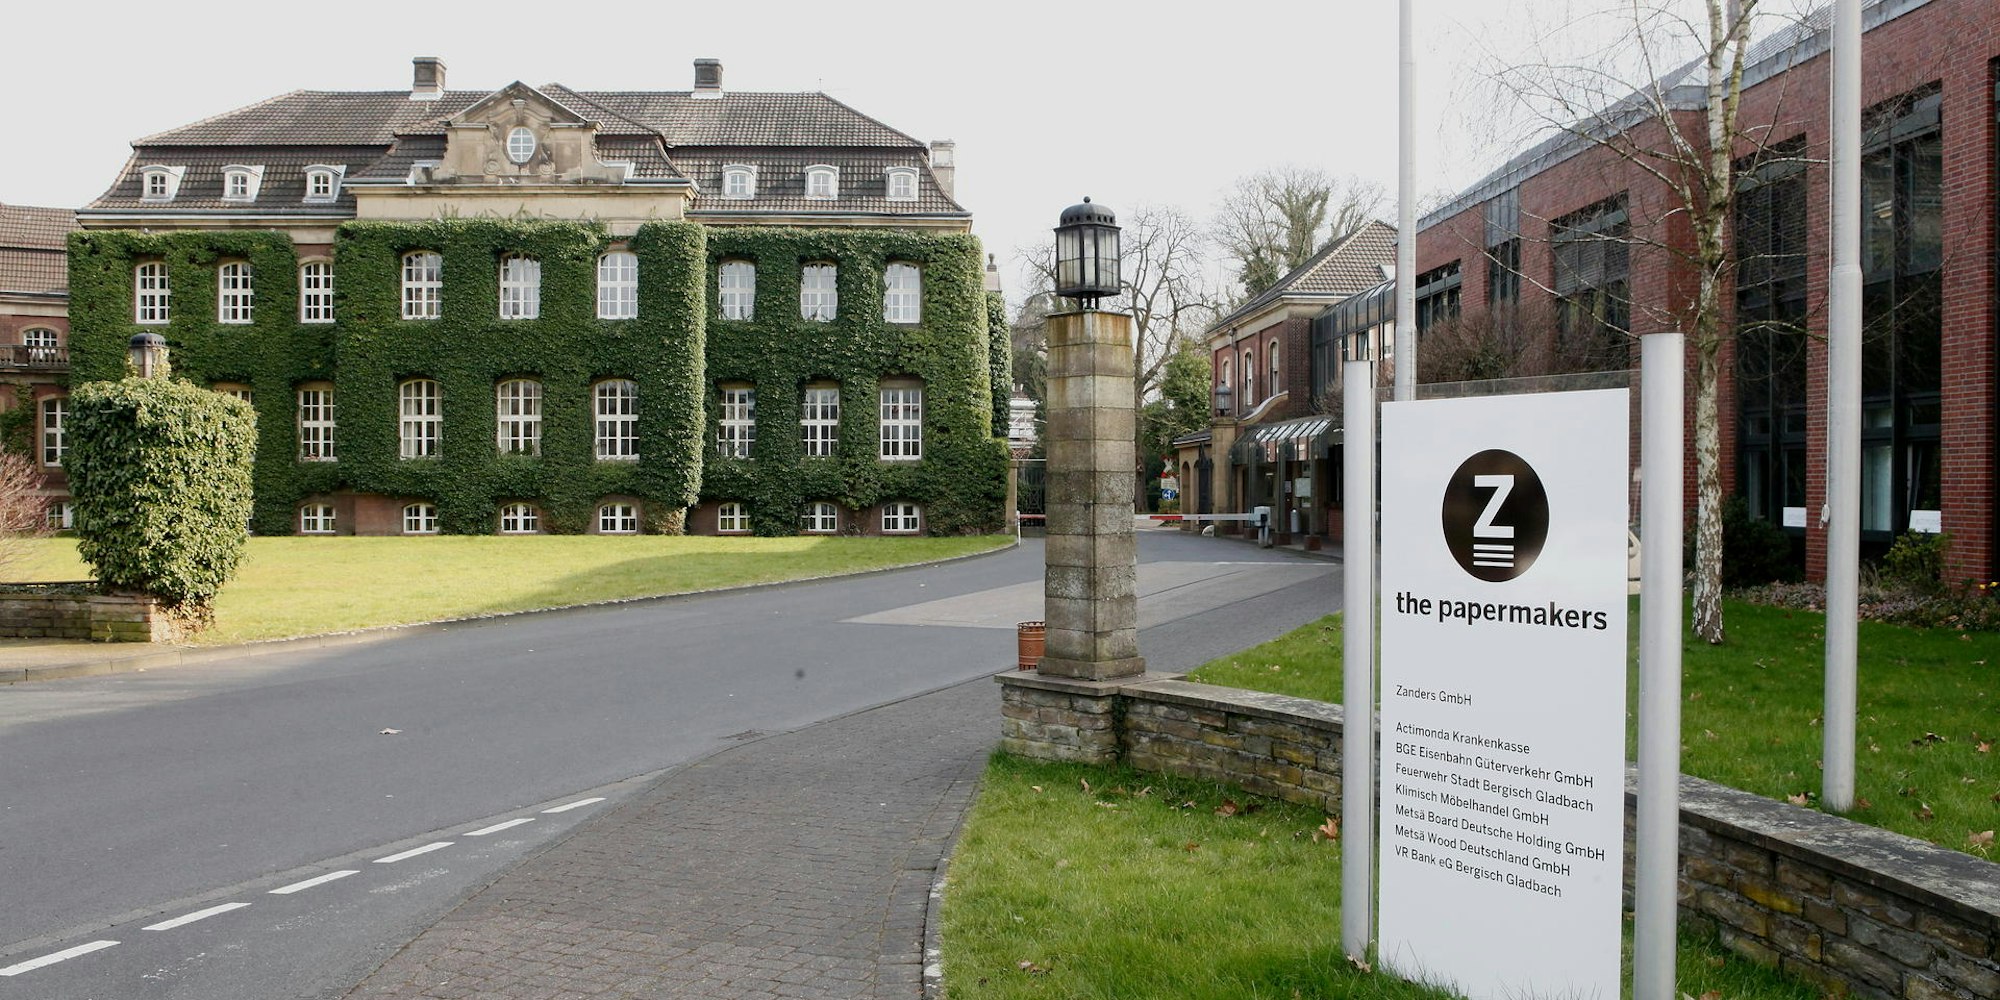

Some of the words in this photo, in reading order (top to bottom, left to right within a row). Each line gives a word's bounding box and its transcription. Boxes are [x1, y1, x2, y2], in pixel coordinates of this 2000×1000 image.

[1473, 474, 1514, 538] Z
[1396, 592, 1432, 615] the
[1439, 600, 1607, 630] papermakers
[1396, 685, 1436, 700] Zanders
[1439, 691, 1472, 706] GmbH
[1396, 722, 1450, 741] Actimonda
[1452, 731, 1530, 754] Krankenkasse
[1395, 763, 1447, 783] Feuerwehr
[1450, 774, 1480, 789] Stadt
[1483, 780, 1532, 800] Bergisch
[1536, 789, 1594, 811] Gladbach
[1396, 743, 1416, 755] BGE
[1419, 747, 1472, 766] Eisenbahn
[1475, 756, 1551, 780] Güterverkehr
[1554, 771, 1594, 788] GmbH
[1395, 783, 1437, 802] Klimisch
[1440, 793, 1509, 817] Möbelhandel
[1512, 808, 1549, 826] GmbH
[1395, 804, 1425, 820] Metsä
[1428, 812, 1458, 828] Board
[1461, 819, 1513, 840] Deutsche
[1516, 831, 1562, 853] Holding
[1565, 842, 1605, 861] GmbH
[1395, 825, 1425, 841] Metsä
[1428, 833, 1457, 849] Wood
[1460, 840, 1529, 866] Deutschland
[1532, 858, 1571, 876] GmbH
[1395, 845, 1408, 858] VR
[1412, 849, 1436, 864] Bank
[1439, 858, 1453, 869] eG
[1456, 861, 1503, 882] Bergisch
[1506, 874, 1562, 897] Gladbach
